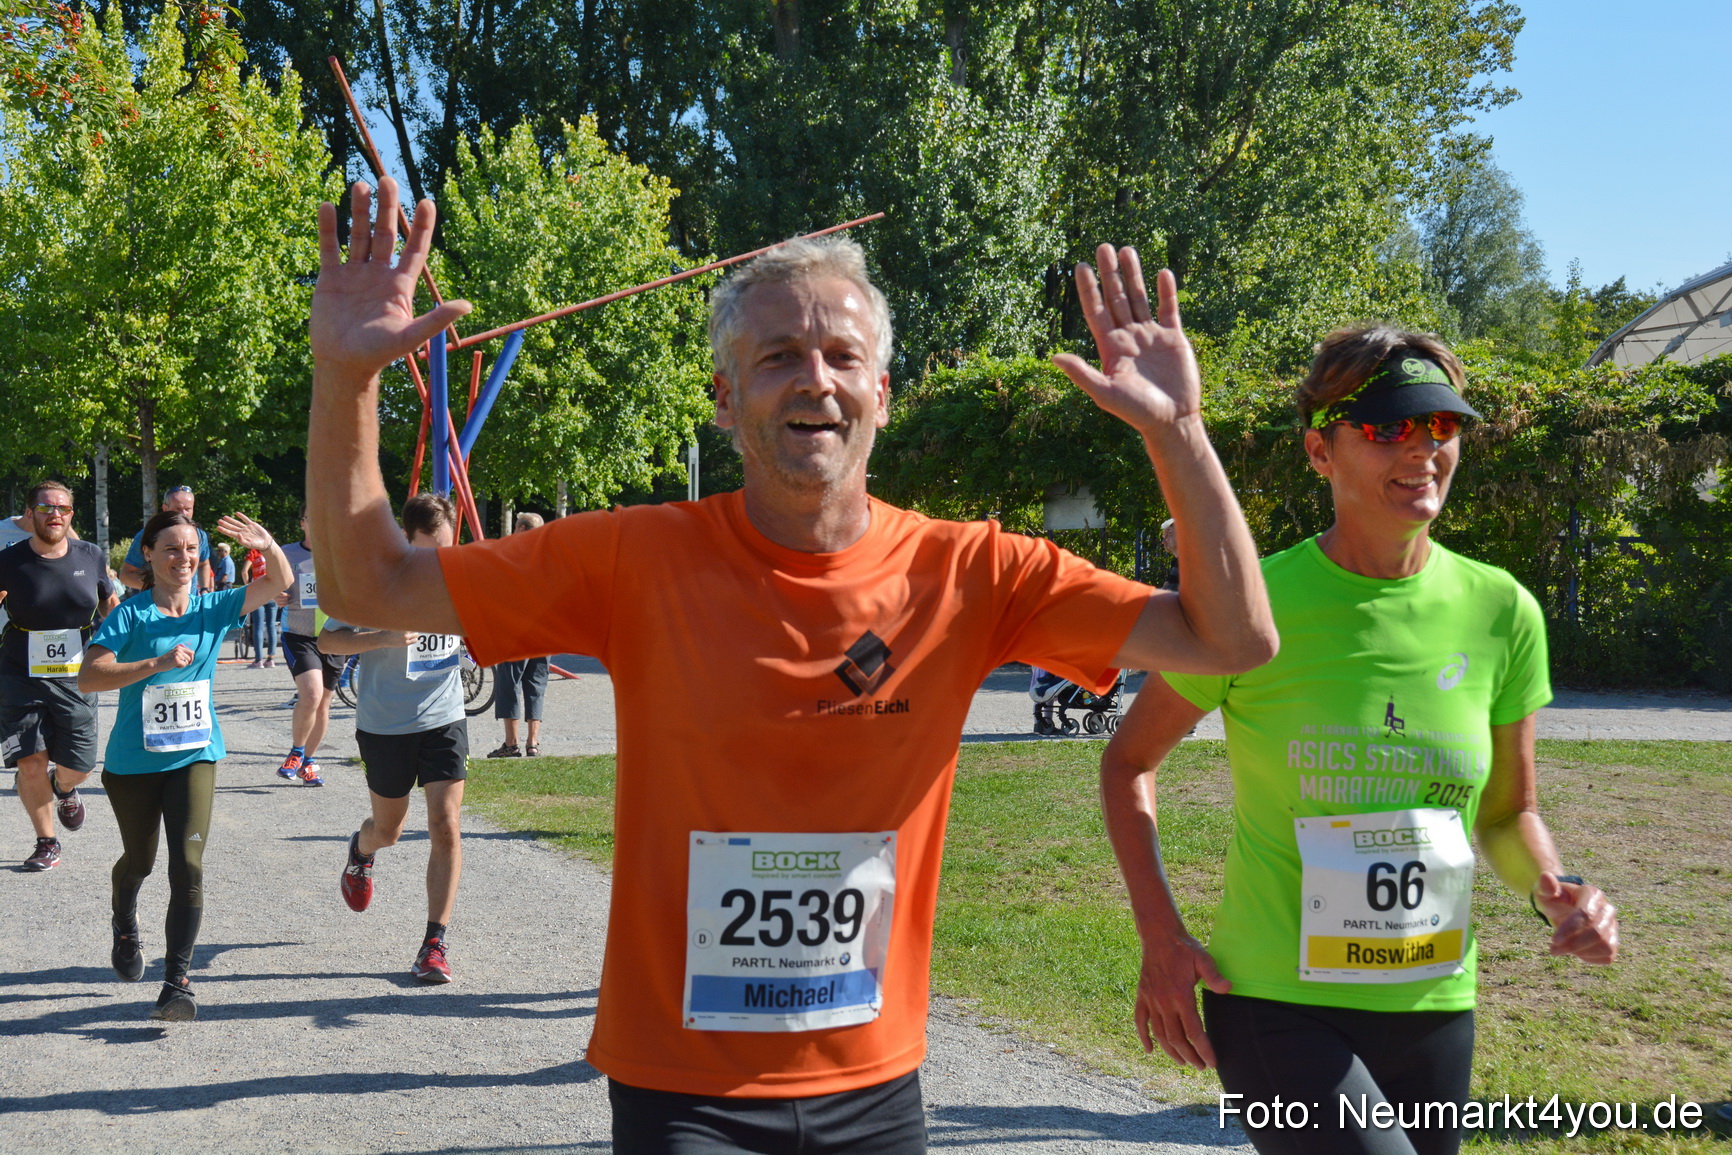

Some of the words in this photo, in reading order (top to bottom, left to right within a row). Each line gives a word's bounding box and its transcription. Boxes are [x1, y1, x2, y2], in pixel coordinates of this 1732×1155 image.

[46, 643, 67, 658] 64
[416, 634, 454, 652] 3015
[154, 700, 202, 723] 3115
[817, 699, 910, 715] FliesenEichl
[1287, 740, 1356, 771] ASICS
[1300, 774, 1421, 804] MARATHON
[1424, 781, 1475, 808] 2015
[1353, 827, 1432, 849] BOCK
[752, 851, 841, 871] BOCK
[1366, 860, 1427, 912] 66
[719, 887, 865, 947] 2539
[1343, 920, 1382, 930] PARTL
[1384, 918, 1428, 931] Neumarkt
[732, 957, 776, 969] PARTL
[778, 956, 836, 969] Neumarkt
[1346, 941, 1434, 965] Roswitha
[744, 980, 835, 1008] Michael
